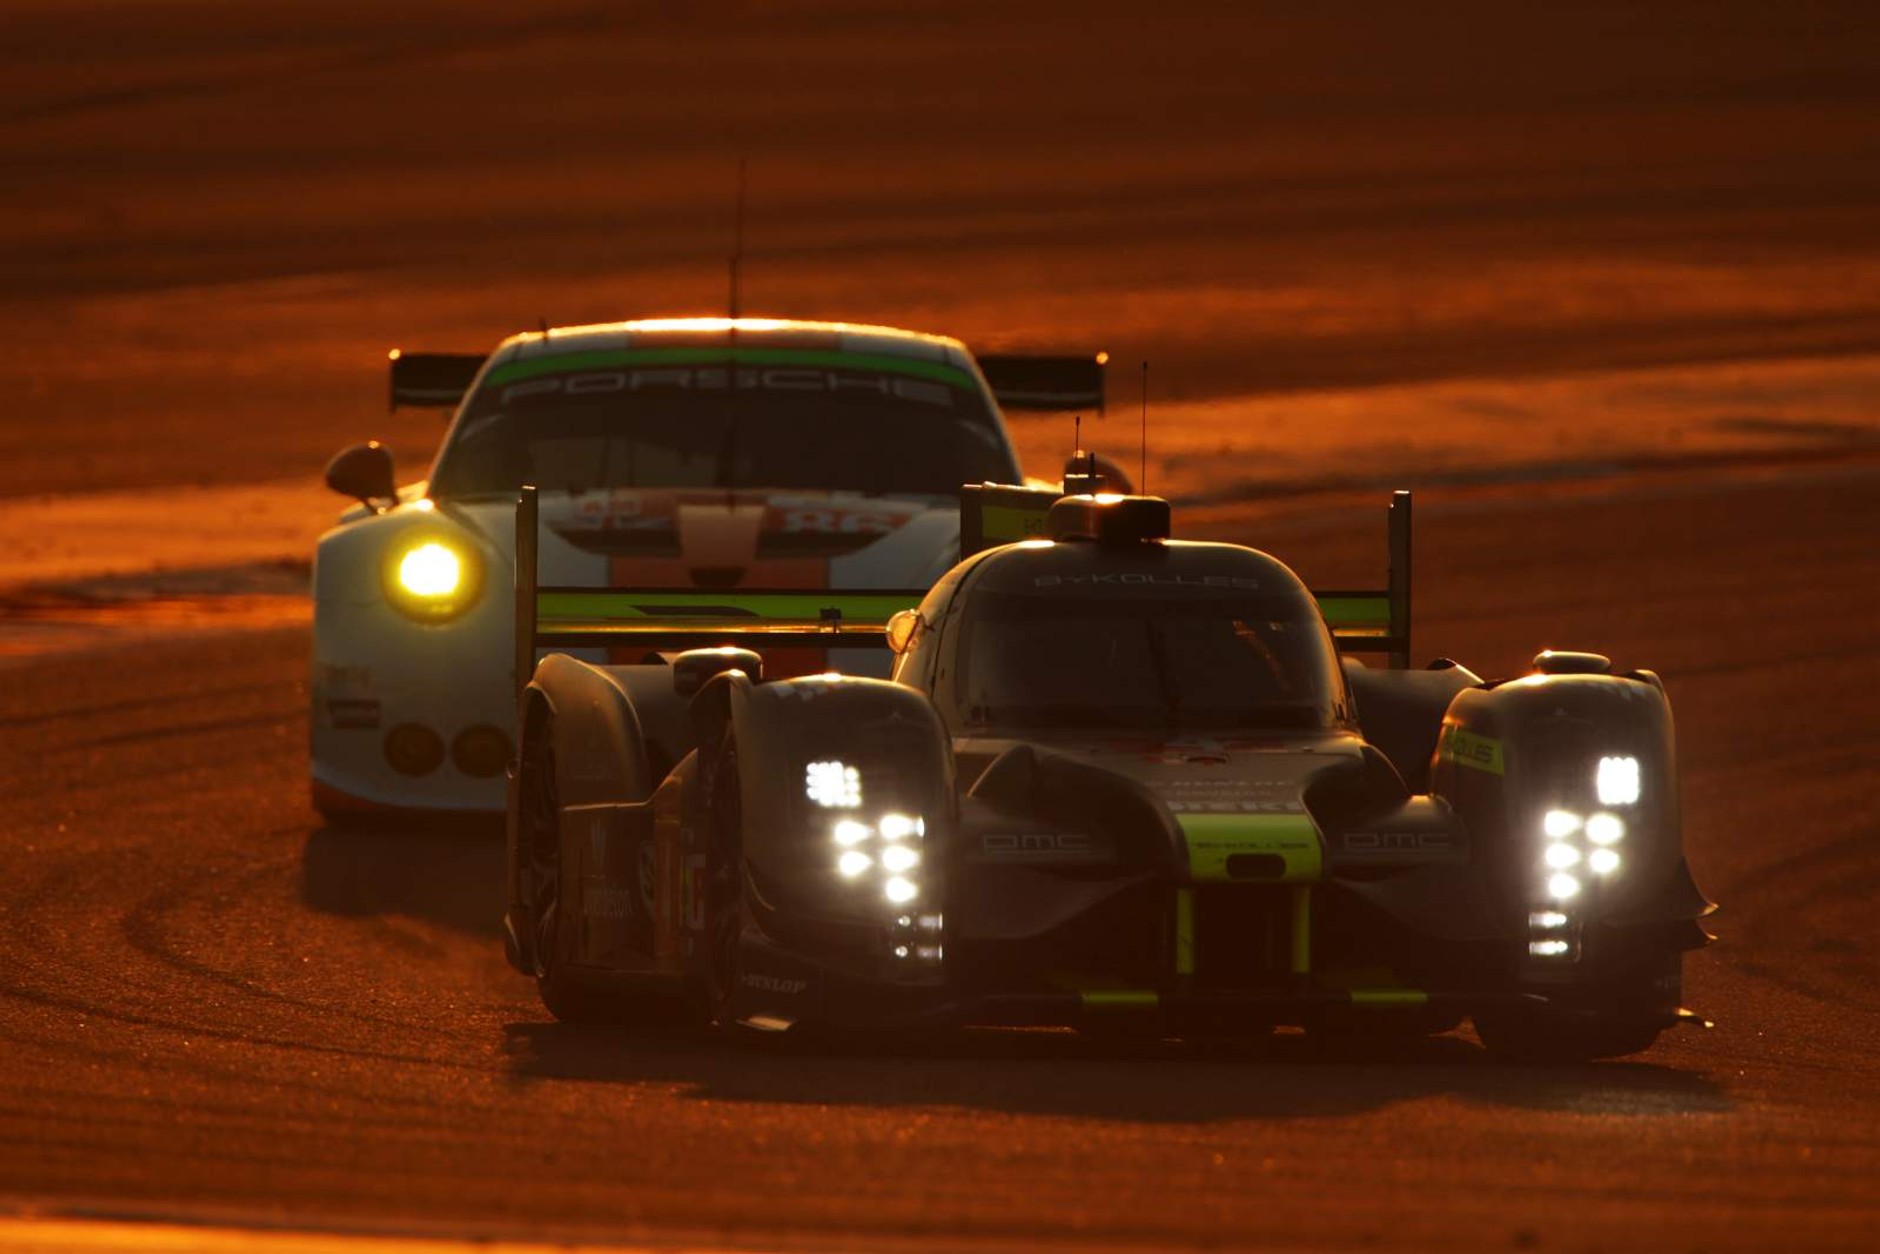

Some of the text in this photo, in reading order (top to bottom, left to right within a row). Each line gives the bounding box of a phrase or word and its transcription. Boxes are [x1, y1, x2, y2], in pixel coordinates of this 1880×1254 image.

[501, 369, 955, 406] PORSCHE
[1033, 573, 1260, 589] BYKOLLES
[746, 973, 808, 995] DUNLOP
